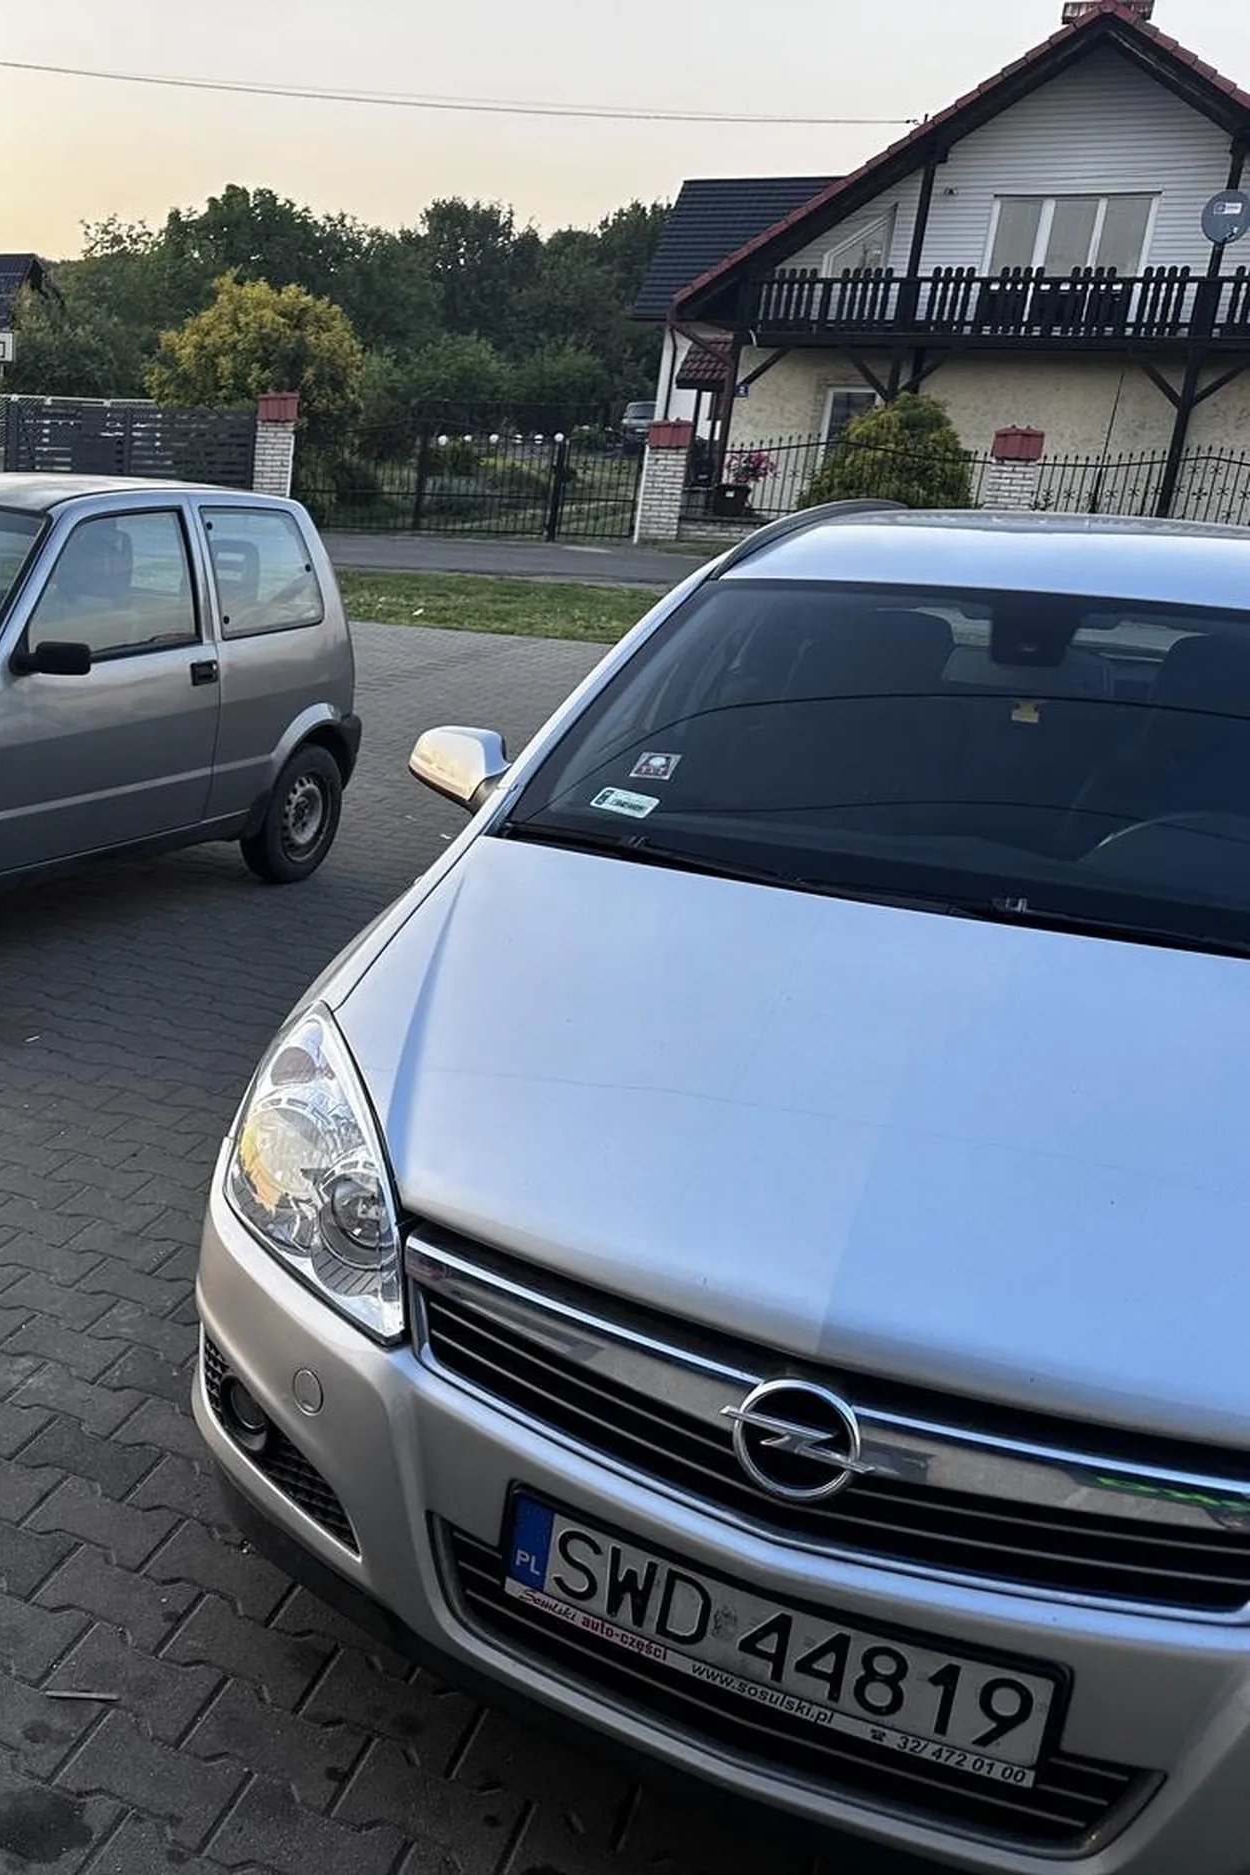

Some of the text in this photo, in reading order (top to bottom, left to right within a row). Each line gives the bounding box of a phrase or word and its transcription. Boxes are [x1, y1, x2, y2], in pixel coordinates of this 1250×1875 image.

[515, 1549, 540, 1576] PL
[553, 1530, 1034, 1747] SWD 44819
[691, 1662, 835, 1725] www.sosulski.pl
[897, 1735, 931, 1755] 32/
[932, 1747, 968, 1768] 472
[971, 1757, 997, 1776] 01
[1000, 1765, 1027, 1784] 00
